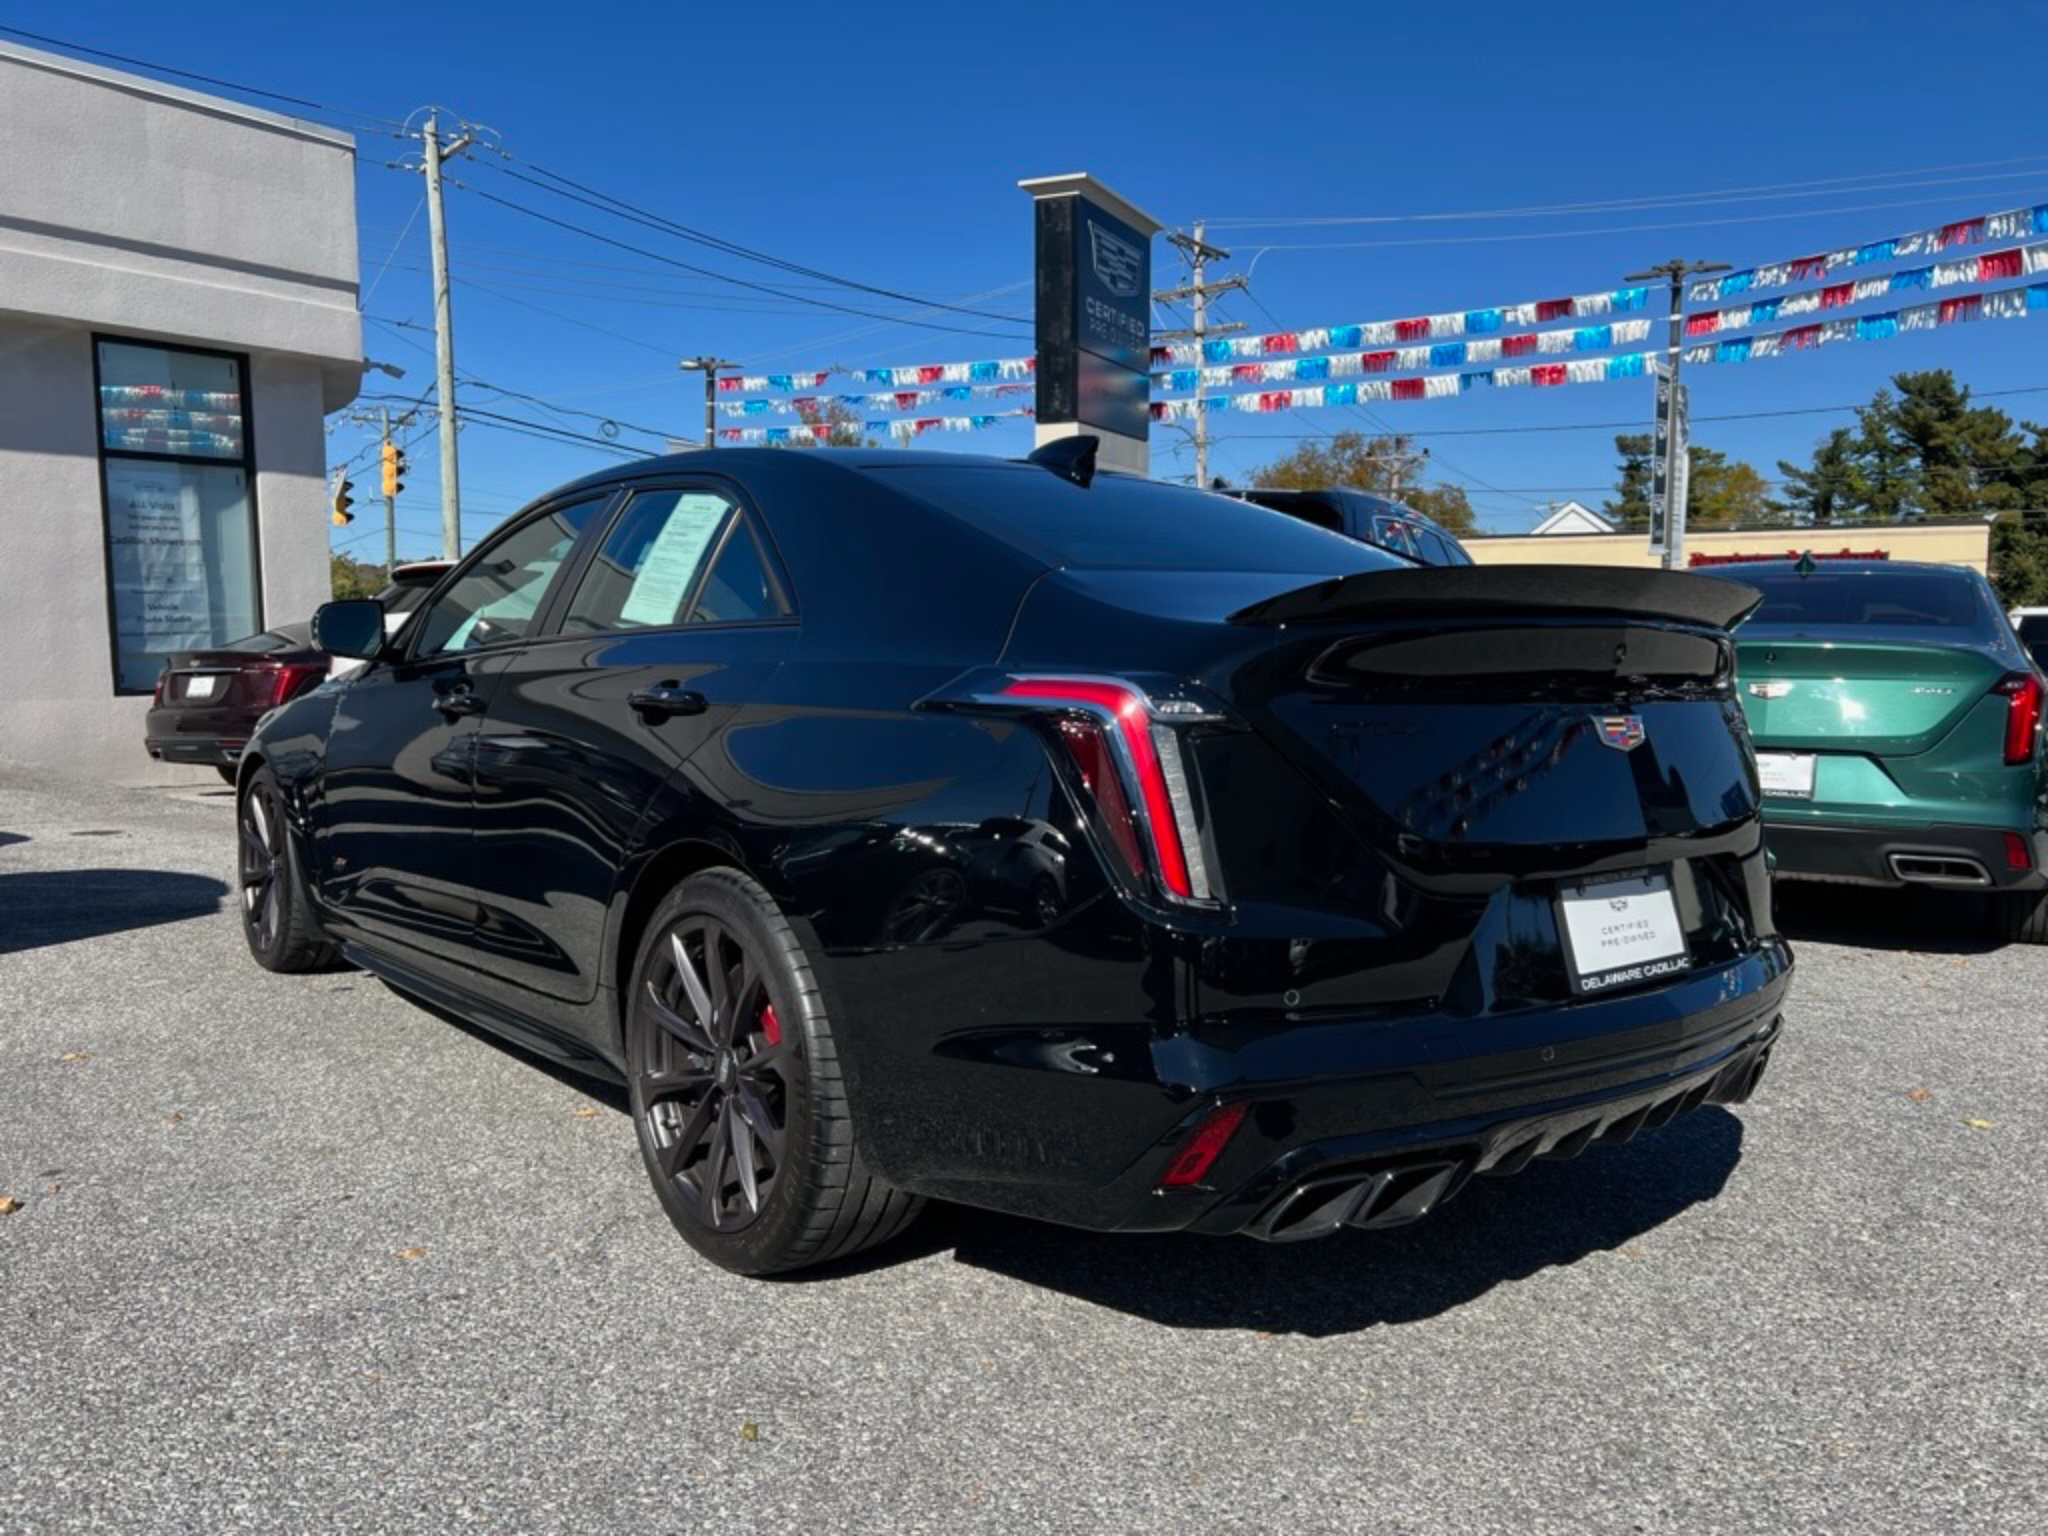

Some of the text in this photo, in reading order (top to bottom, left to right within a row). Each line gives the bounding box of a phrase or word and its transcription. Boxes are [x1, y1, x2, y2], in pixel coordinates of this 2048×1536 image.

[1086, 296, 1145, 337] CERTIFIED
[1600, 931, 1656, 947] PRE-OWNED
[1601, 919, 1650, 936] CERTIFIED
[1582, 957, 1689, 990] DELAWARE CADILLAC
